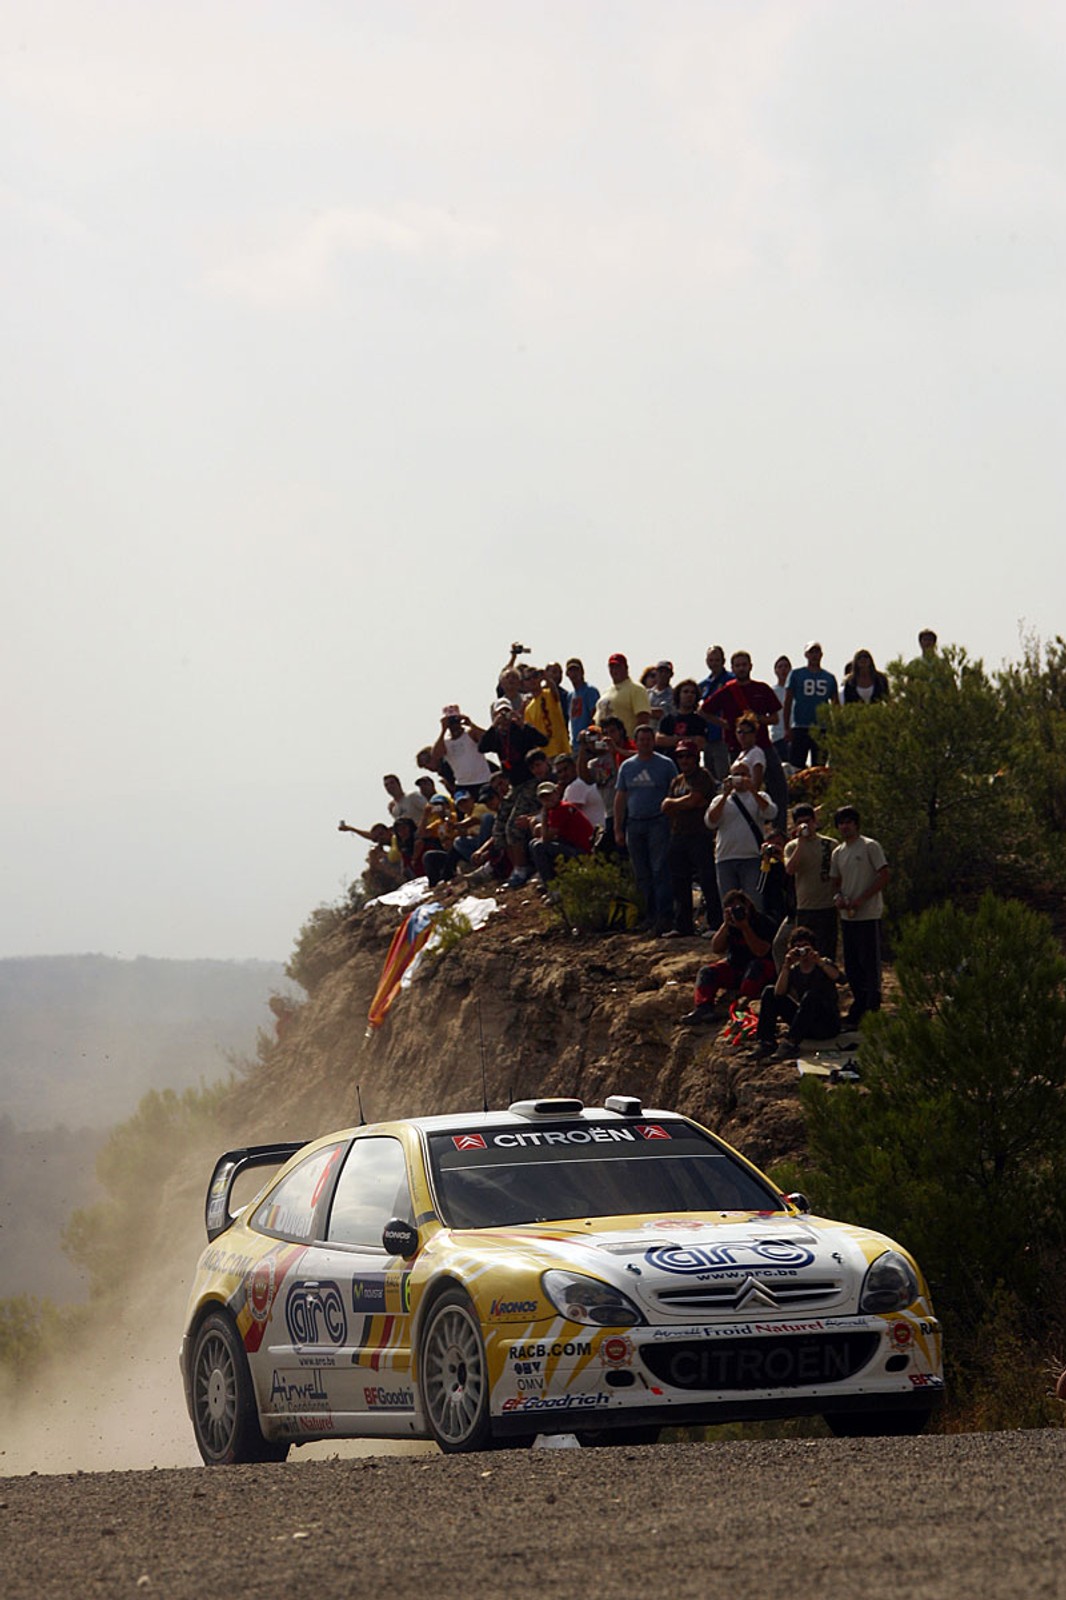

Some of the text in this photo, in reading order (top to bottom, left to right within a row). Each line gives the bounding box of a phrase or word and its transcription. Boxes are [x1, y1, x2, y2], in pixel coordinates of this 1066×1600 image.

[803, 679, 827, 696] 85
[493, 1127, 636, 1148] CITROËN
[385, 1231, 411, 1240] RONOS
[697, 1270, 798, 1281] www.arc.be
[490, 1296, 538, 1316] KRONOS
[704, 1325, 752, 1337] Froid
[755, 1321, 823, 1333] Naturel
[510, 1343, 592, 1359] RACB.COM
[670, 1339, 850, 1385] CITROËN
[270, 1369, 327, 1402] Airwell
[517, 1378, 544, 1391] OMV
[502, 1393, 609, 1411] BFGoodrich
